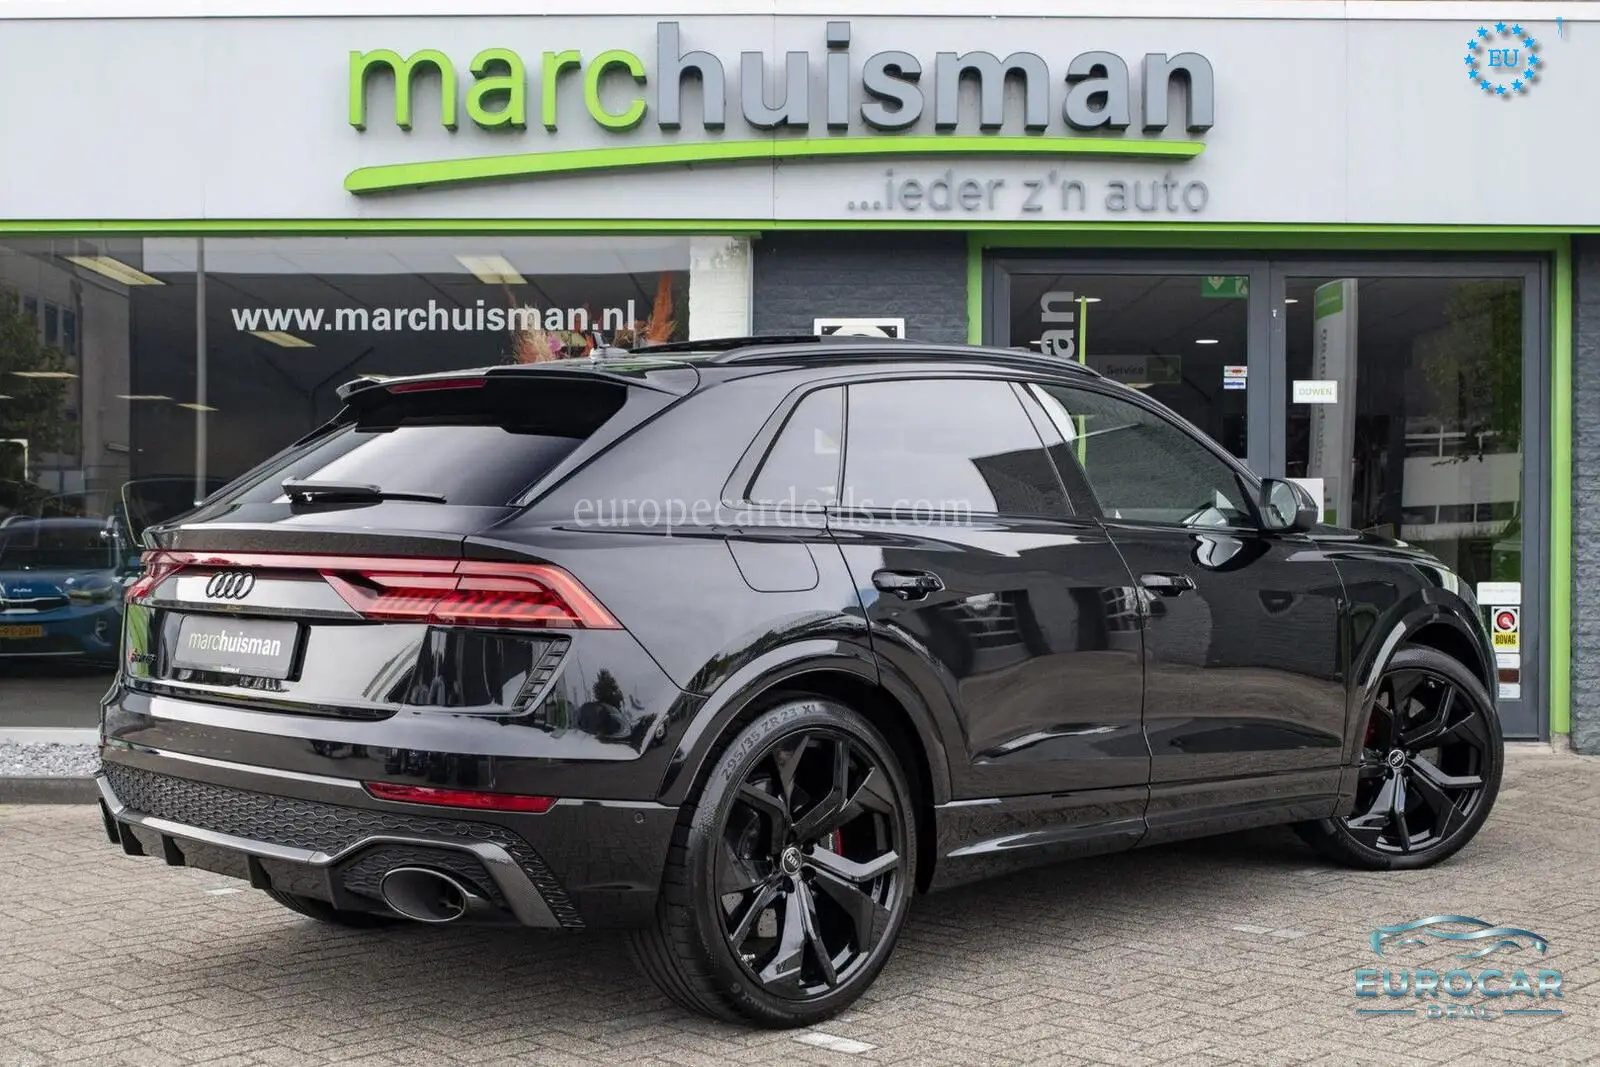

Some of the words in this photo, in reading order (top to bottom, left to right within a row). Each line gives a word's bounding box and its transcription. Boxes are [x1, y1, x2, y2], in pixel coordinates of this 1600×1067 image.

[349, 21, 1216, 133] marchuisman
[847, 168, 1006, 213] ...ieder
[1021, 169, 1087, 213] z'n
[1104, 171, 1210, 213] auto
[231, 299, 636, 332] www.marchuisman.nl
[188, 629, 282, 657] marchuisman
[1495, 633, 1517, 646] BOVAG
